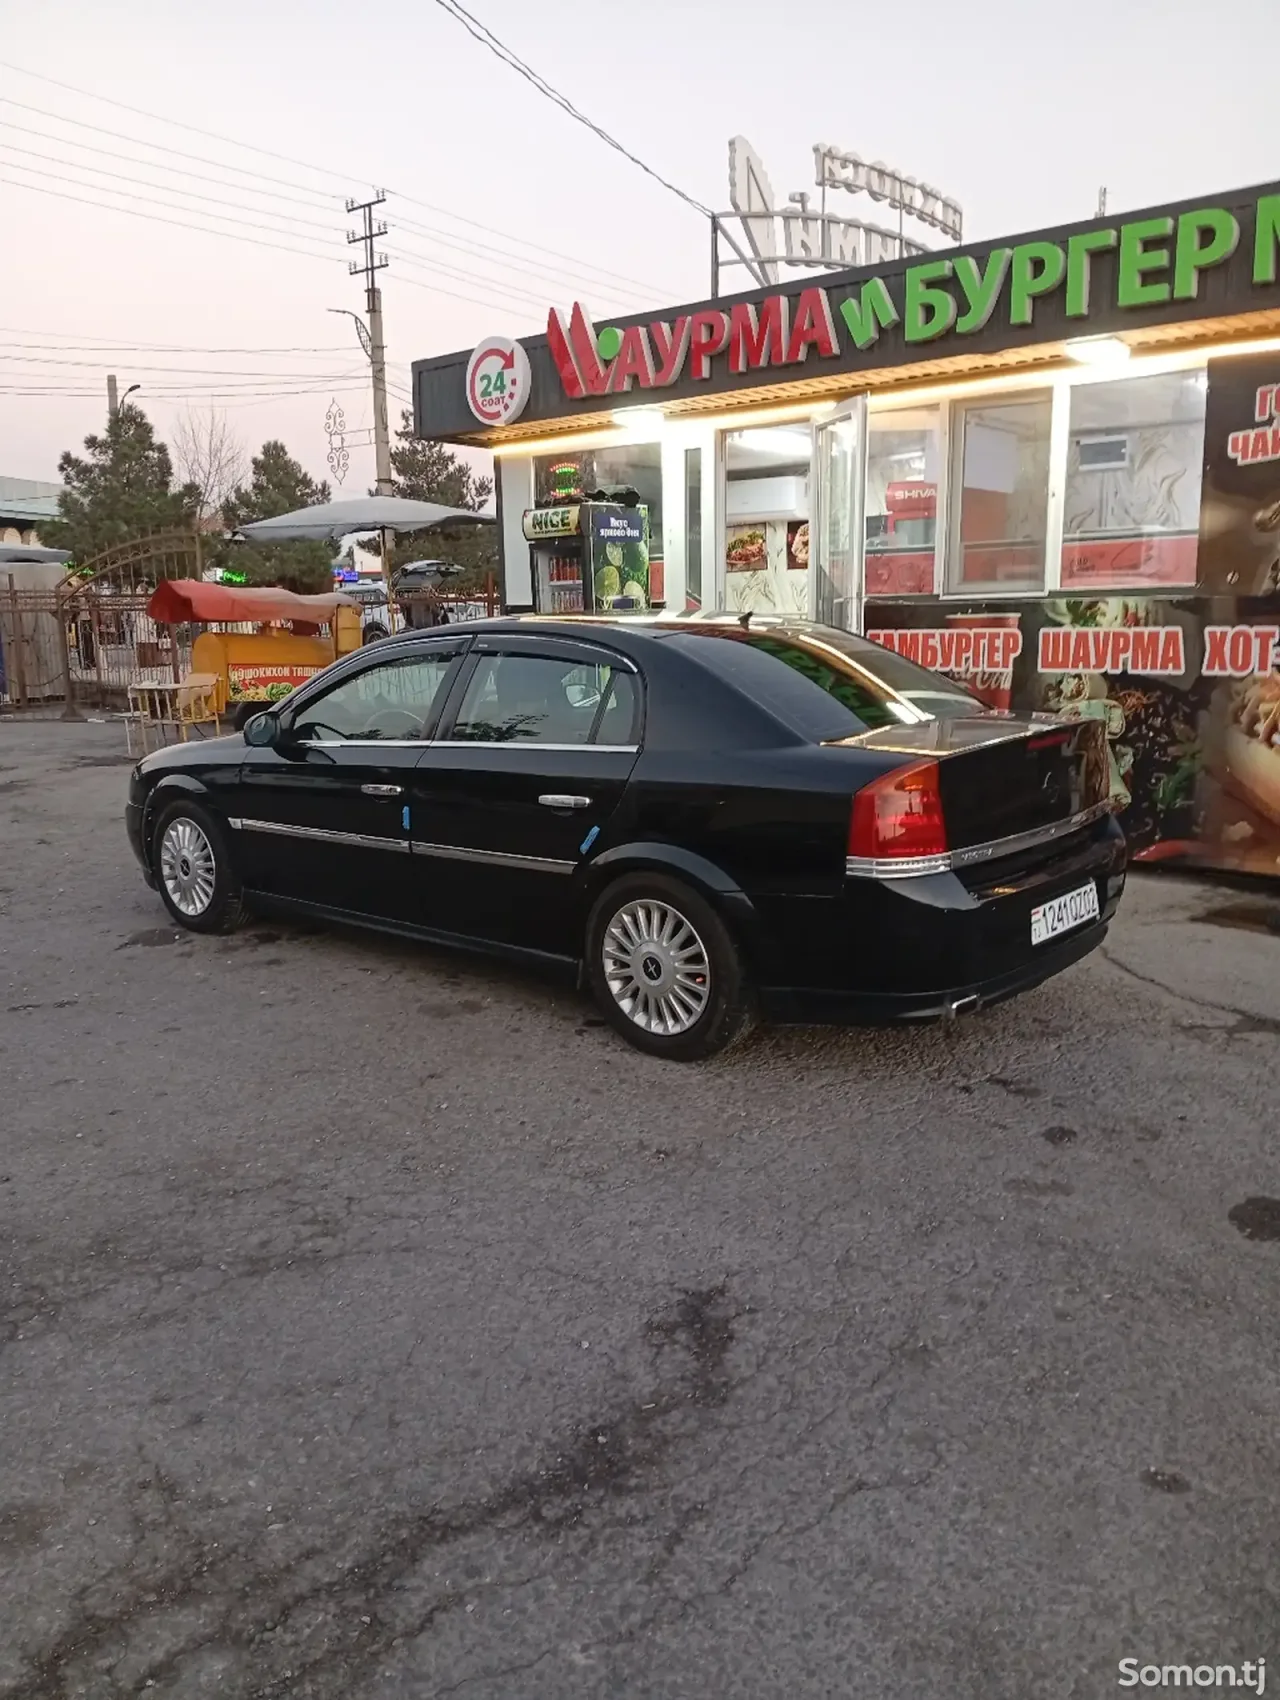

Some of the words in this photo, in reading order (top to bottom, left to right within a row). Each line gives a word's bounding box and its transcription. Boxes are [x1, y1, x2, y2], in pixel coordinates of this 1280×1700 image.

[547, 287, 840, 398] ШАУРМА
[904, 208, 1240, 342] БУРГЕР
[480, 370, 506, 398] 24
[532, 509, 571, 531] NICE
[1040, 627, 1183, 673] ШАУРМА
